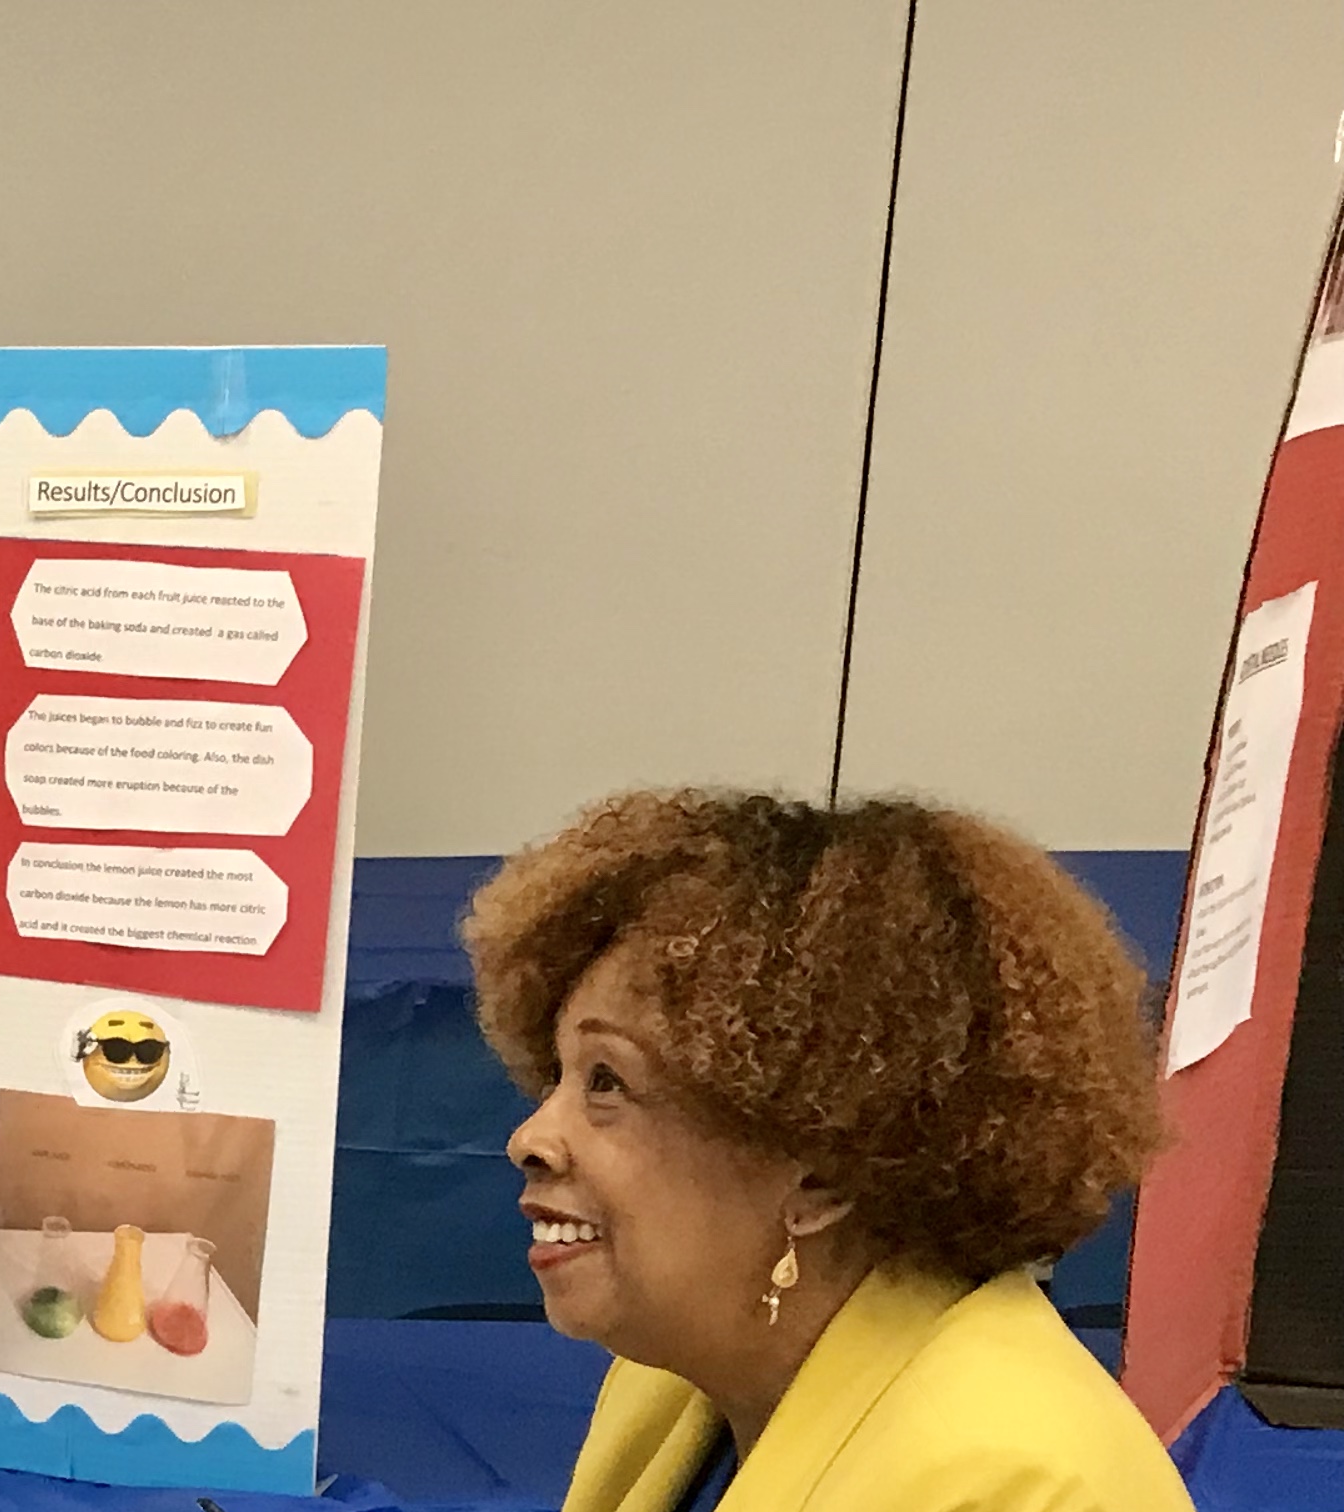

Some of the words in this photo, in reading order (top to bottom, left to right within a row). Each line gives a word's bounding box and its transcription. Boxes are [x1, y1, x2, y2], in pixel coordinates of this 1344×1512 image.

[36, 481, 236, 506] Results/Conclusion
[34, 583, 51, 594] The
[54, 585, 78, 596] citric
[81, 587, 101, 597] acid
[104, 587, 128, 598] from
[131, 590, 155, 600] each
[158, 590, 180, 602] fruit
[182, 593, 207, 605] juice
[210, 595, 250, 607] reacted
[253, 598, 264, 608] to
[268, 598, 284, 609] the
[32, 616, 54, 626] base
[57, 617, 67, 627] of
[69, 618, 85, 628] the
[89, 619, 121, 633] baking
[124, 622, 147, 633] soda
[150, 623, 169, 634] and
[172, 626, 212, 636] created
[218, 630, 224, 638] a
[227, 630, 244, 641] gas
[247, 630, 278, 641] called
[30, 648, 62, 659] carbon
[28, 711, 46, 721] The
[48, 712, 77, 723] juices
[80, 714, 109, 726] began
[112, 716, 123, 725] to
[126, 716, 162, 727] bubble
[164, 718, 183, 728] and
[186, 718, 202, 729] fizz
[205, 720, 216, 729] to
[219, 721, 252, 731] create
[255, 722, 273, 732] fun
[24, 743, 54, 753] colors
[56, 744, 95, 756] because
[98, 746, 109, 756] of
[111, 747, 128, 757] the
[130, 748, 155, 758] food
[232, 753, 249, 764] the
[253, 754, 274, 764] dish
[23, 775, 46, 785] soap
[49, 775, 84, 787] created
[87, 779, 113, 788] more
[116, 779, 160, 792] eruption
[163, 781, 204, 794] because
[207, 784, 218, 795] of
[220, 784, 239, 796] the
[21, 858, 30, 867] In
[86, 862, 102, 872] the
[104, 863, 135, 874] lemon
[137, 864, 162, 877] juice
[165, 867, 203, 879] created
[206, 869, 224, 880] the
[226, 871, 253, 882] most
[20, 889, 53, 900] carbon
[55, 891, 90, 903] dioxide
[92, 893, 131, 905] because
[134, 896, 152, 907] the
[154, 897, 187, 909] lemon
[190, 899, 207, 910] has
[210, 903, 236, 912] more
[239, 903, 265, 915] citric
[19, 919, 38, 930] acid
[41, 920, 58, 931] and
[61, 922, 67, 931] it
[70, 923, 105, 935] created
[108, 925, 124, 936] the
[127, 927, 164, 940] biggest
[167, 930, 211, 942] chemical
